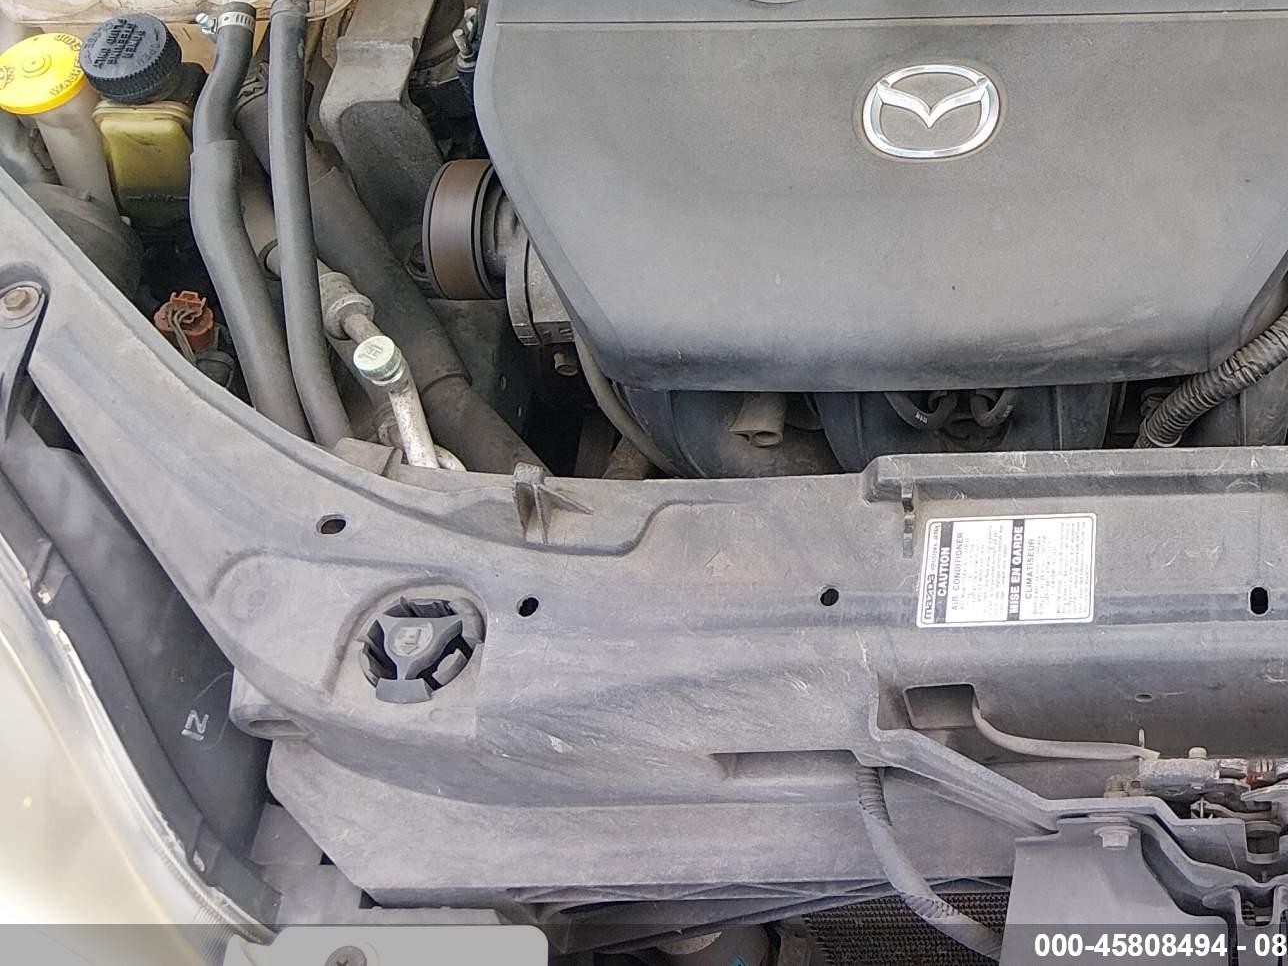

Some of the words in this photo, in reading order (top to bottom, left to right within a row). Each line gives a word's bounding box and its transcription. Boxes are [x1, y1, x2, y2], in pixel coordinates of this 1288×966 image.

[953, 532, 964, 592] CONDITIONER
[1012, 525, 1024, 566] GARDE
[937, 546, 951, 597] CAUTION
[1011, 567, 1021, 585] EN
[1024, 538, 1035, 600] CLIMATISEUR
[924, 574, 936, 620] mazda
[951, 596, 960, 611] AIR
[1009, 586, 1020, 614] MISE
